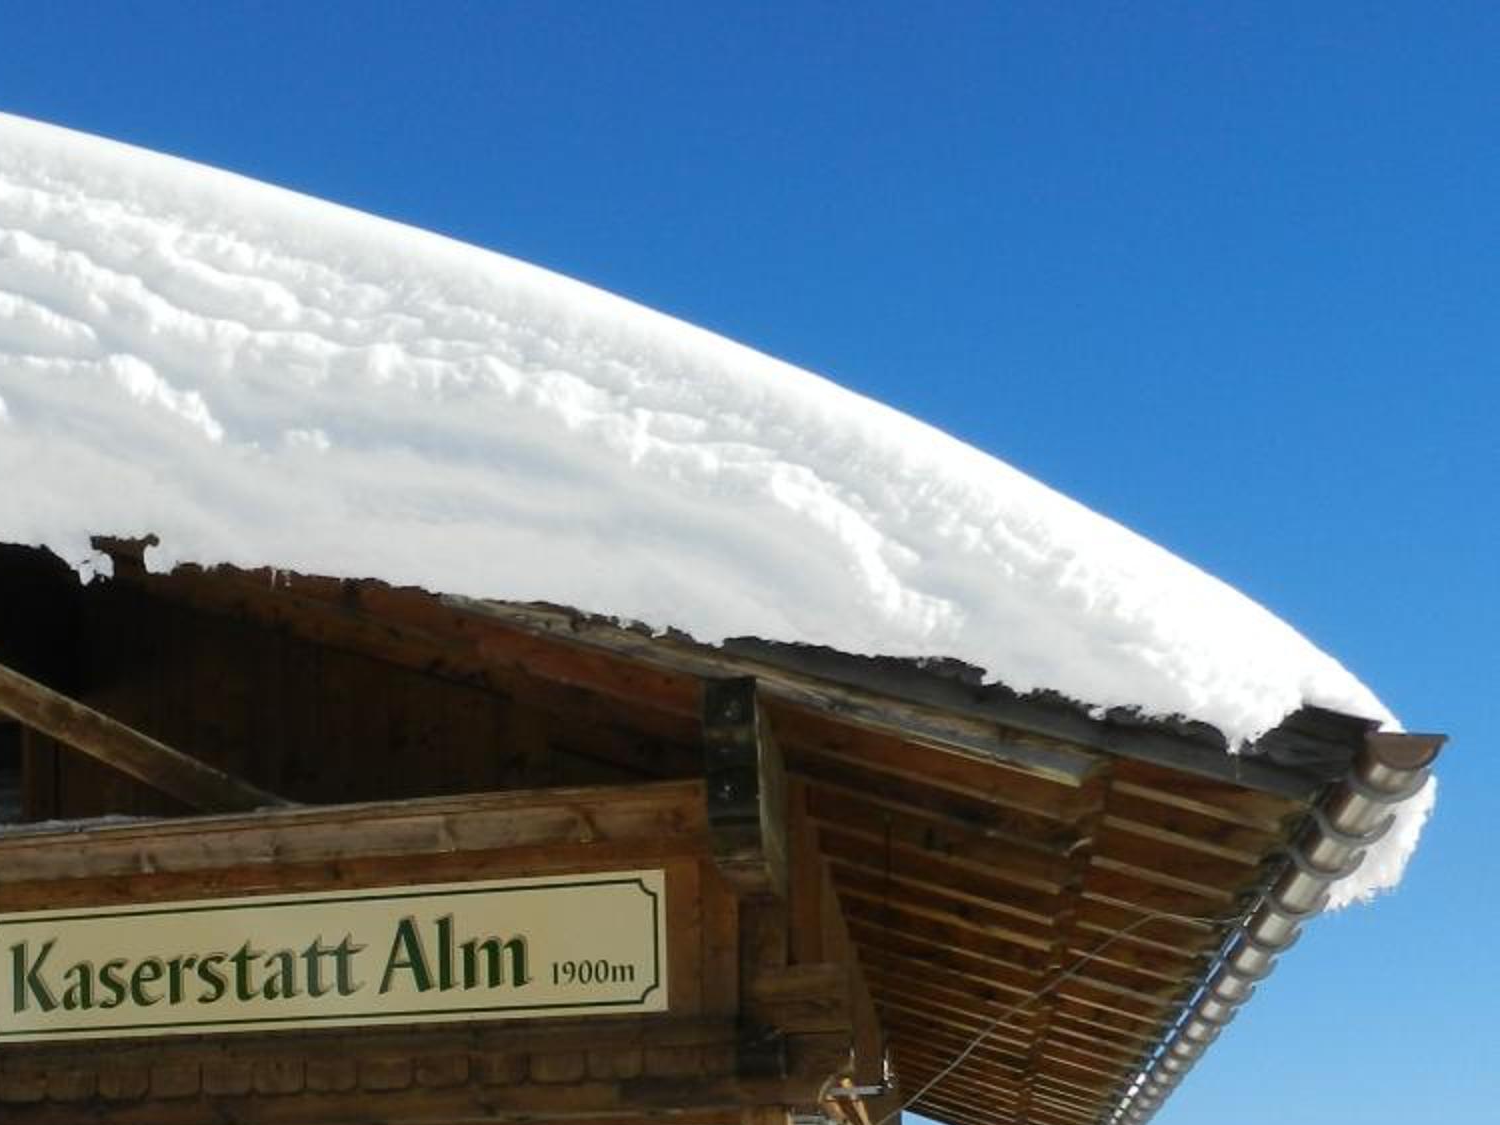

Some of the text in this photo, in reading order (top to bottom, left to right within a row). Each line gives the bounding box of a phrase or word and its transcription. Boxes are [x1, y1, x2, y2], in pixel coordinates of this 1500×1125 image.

[10, 913, 636, 1014] Kaserstatt Alm 1900m
